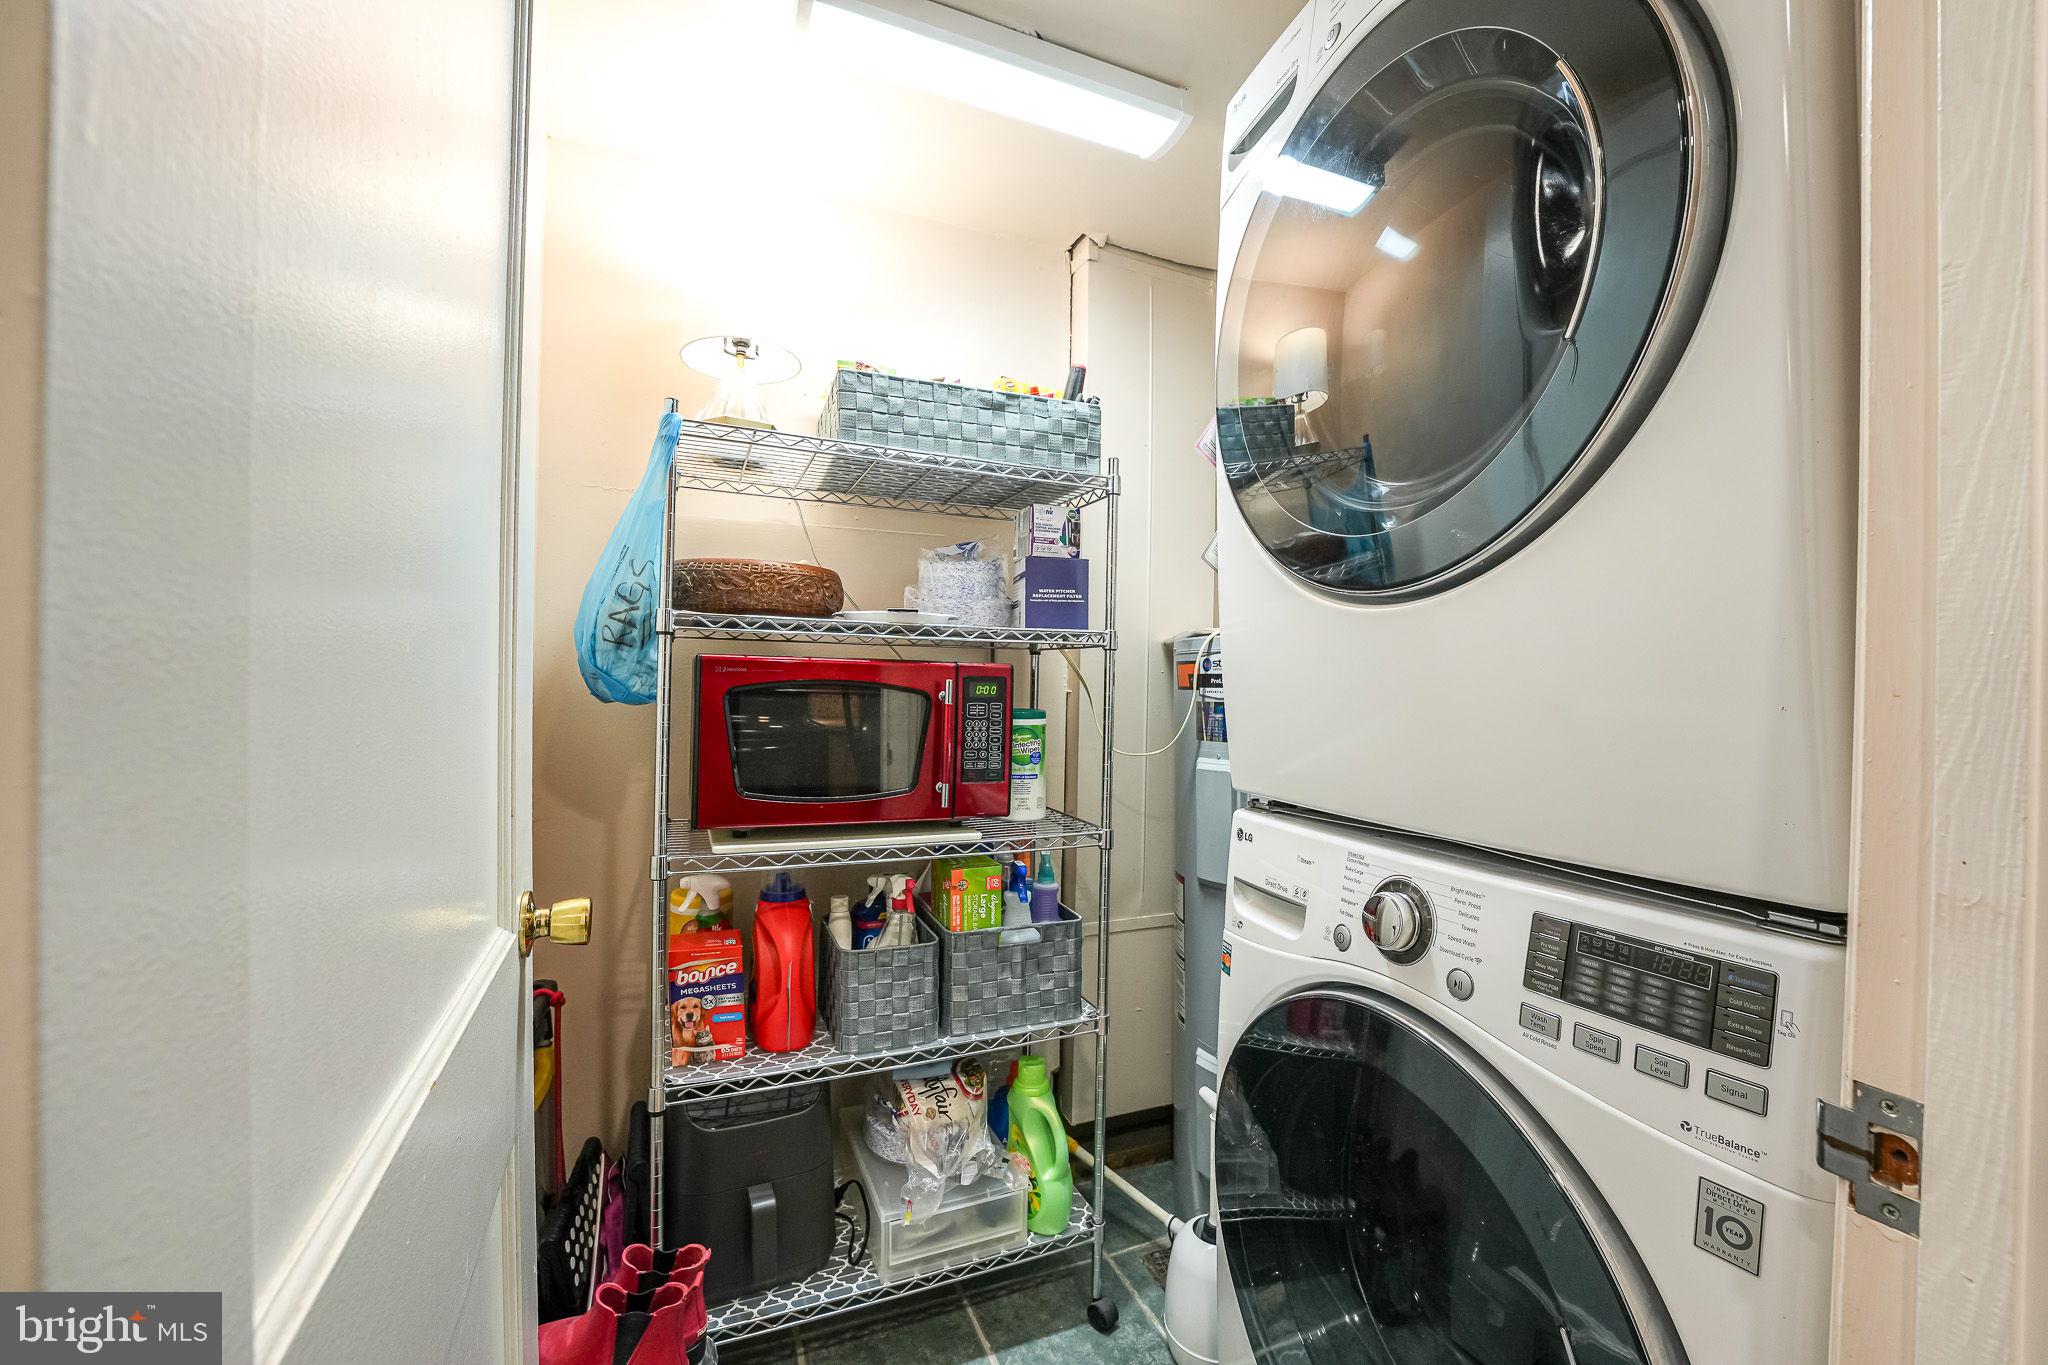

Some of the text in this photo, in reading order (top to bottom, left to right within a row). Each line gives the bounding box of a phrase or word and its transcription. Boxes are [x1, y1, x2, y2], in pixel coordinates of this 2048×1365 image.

[602, 559, 656, 647] RAGS
[976, 685, 997, 695] 0:00
[1244, 832, 1254, 843] LG
[978, 894, 988, 918] Large
[1458, 910, 1480, 922] Delicates
[1461, 924, 1478, 934] Towels
[1439, 945, 1461, 958] Download
[1748, 958, 1773, 968] Functions
[676, 961, 738, 987] bounce
[680, 983, 737, 996] MEGASHEETS
[1729, 997, 1761, 1012] Cold Wash
[1530, 1012, 1548, 1024] Wash
[1728, 1020, 1762, 1035] Extra Rinse
[1529, 1034, 1541, 1044] Cold
[1540, 1038, 1558, 1050] Rinses
[1588, 1033, 1604, 1045] Spin
[1585, 1040, 1607, 1054] Speed
[1654, 1057, 1668, 1068] Soil
[1650, 1064, 1671, 1078] Level
[1720, 1084, 1748, 1100] Signal
[1706, 1187, 1756, 1216] Direct Drive
[1713, 1185, 1749, 1205] INVERTER
[1704, 1205, 1754, 1250] 10
[1725, 1225, 1744, 1240] YEAR
[1702, 1239, 1751, 1267] WARRANTY
